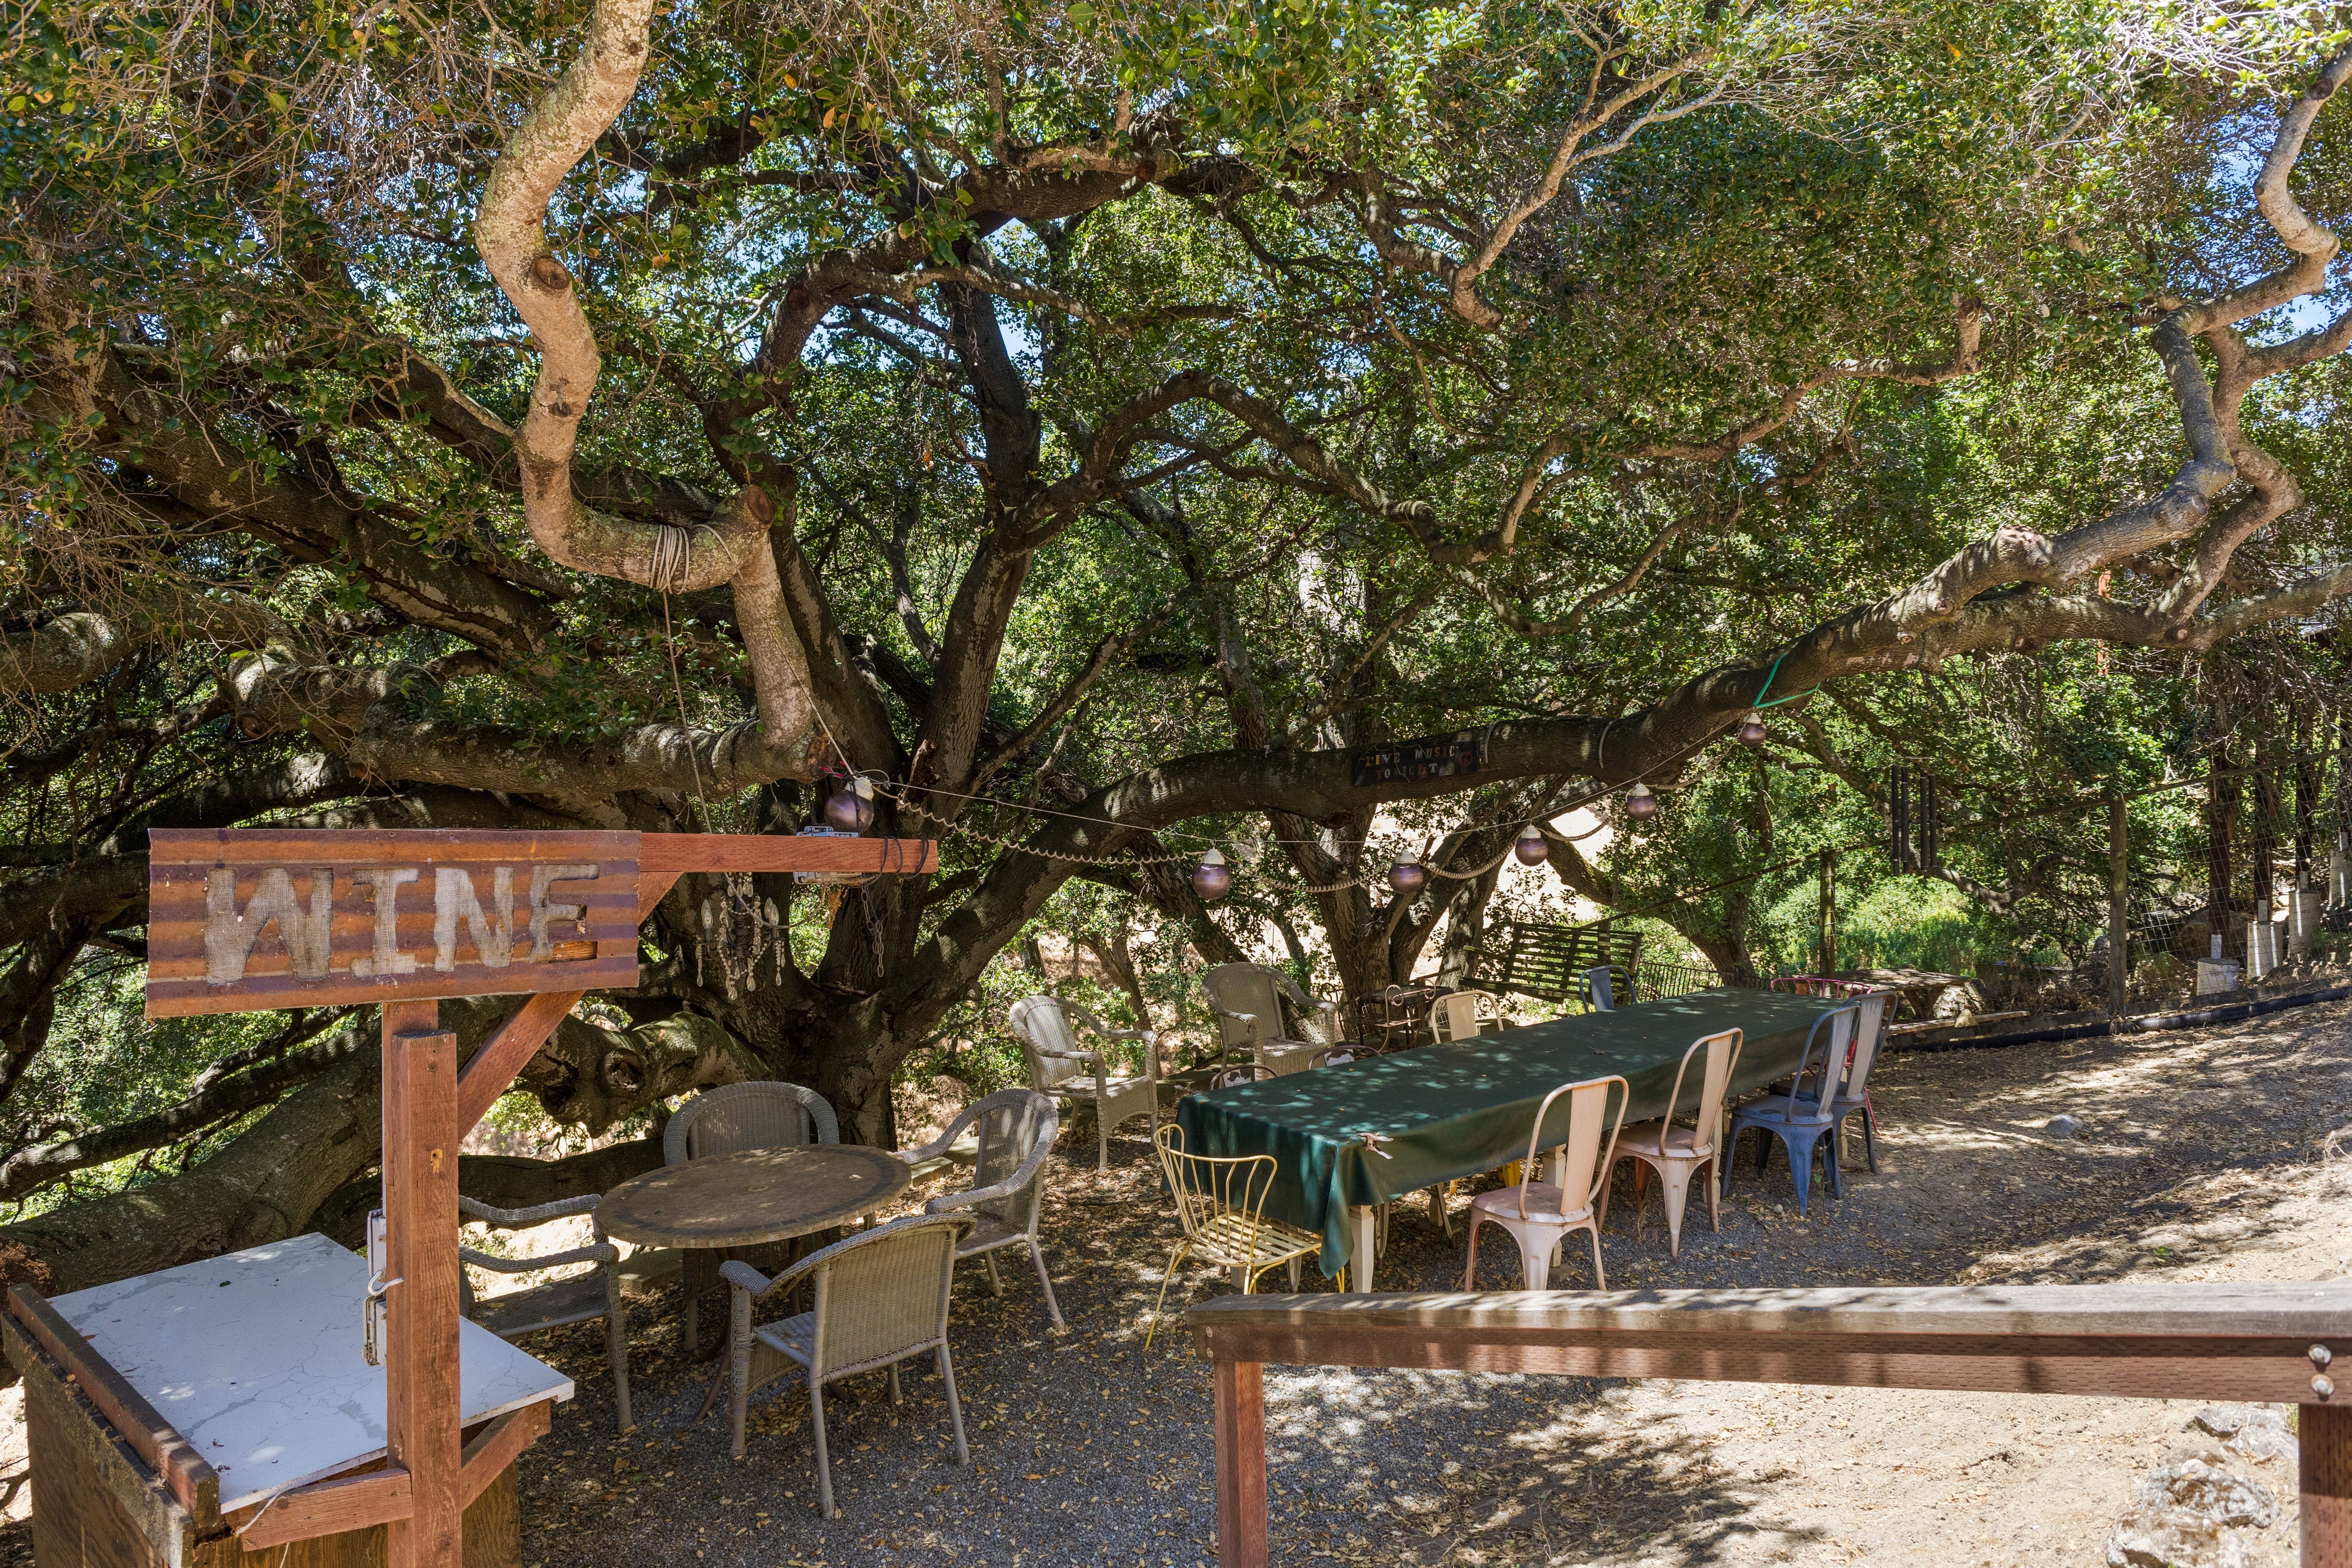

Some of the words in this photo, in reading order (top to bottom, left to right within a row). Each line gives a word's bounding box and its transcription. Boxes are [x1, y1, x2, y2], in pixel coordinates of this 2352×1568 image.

[1365, 753, 1400, 766] LIVE
[1415, 746, 1455, 759] MUSIC
[205, 864, 598, 984] WINE
